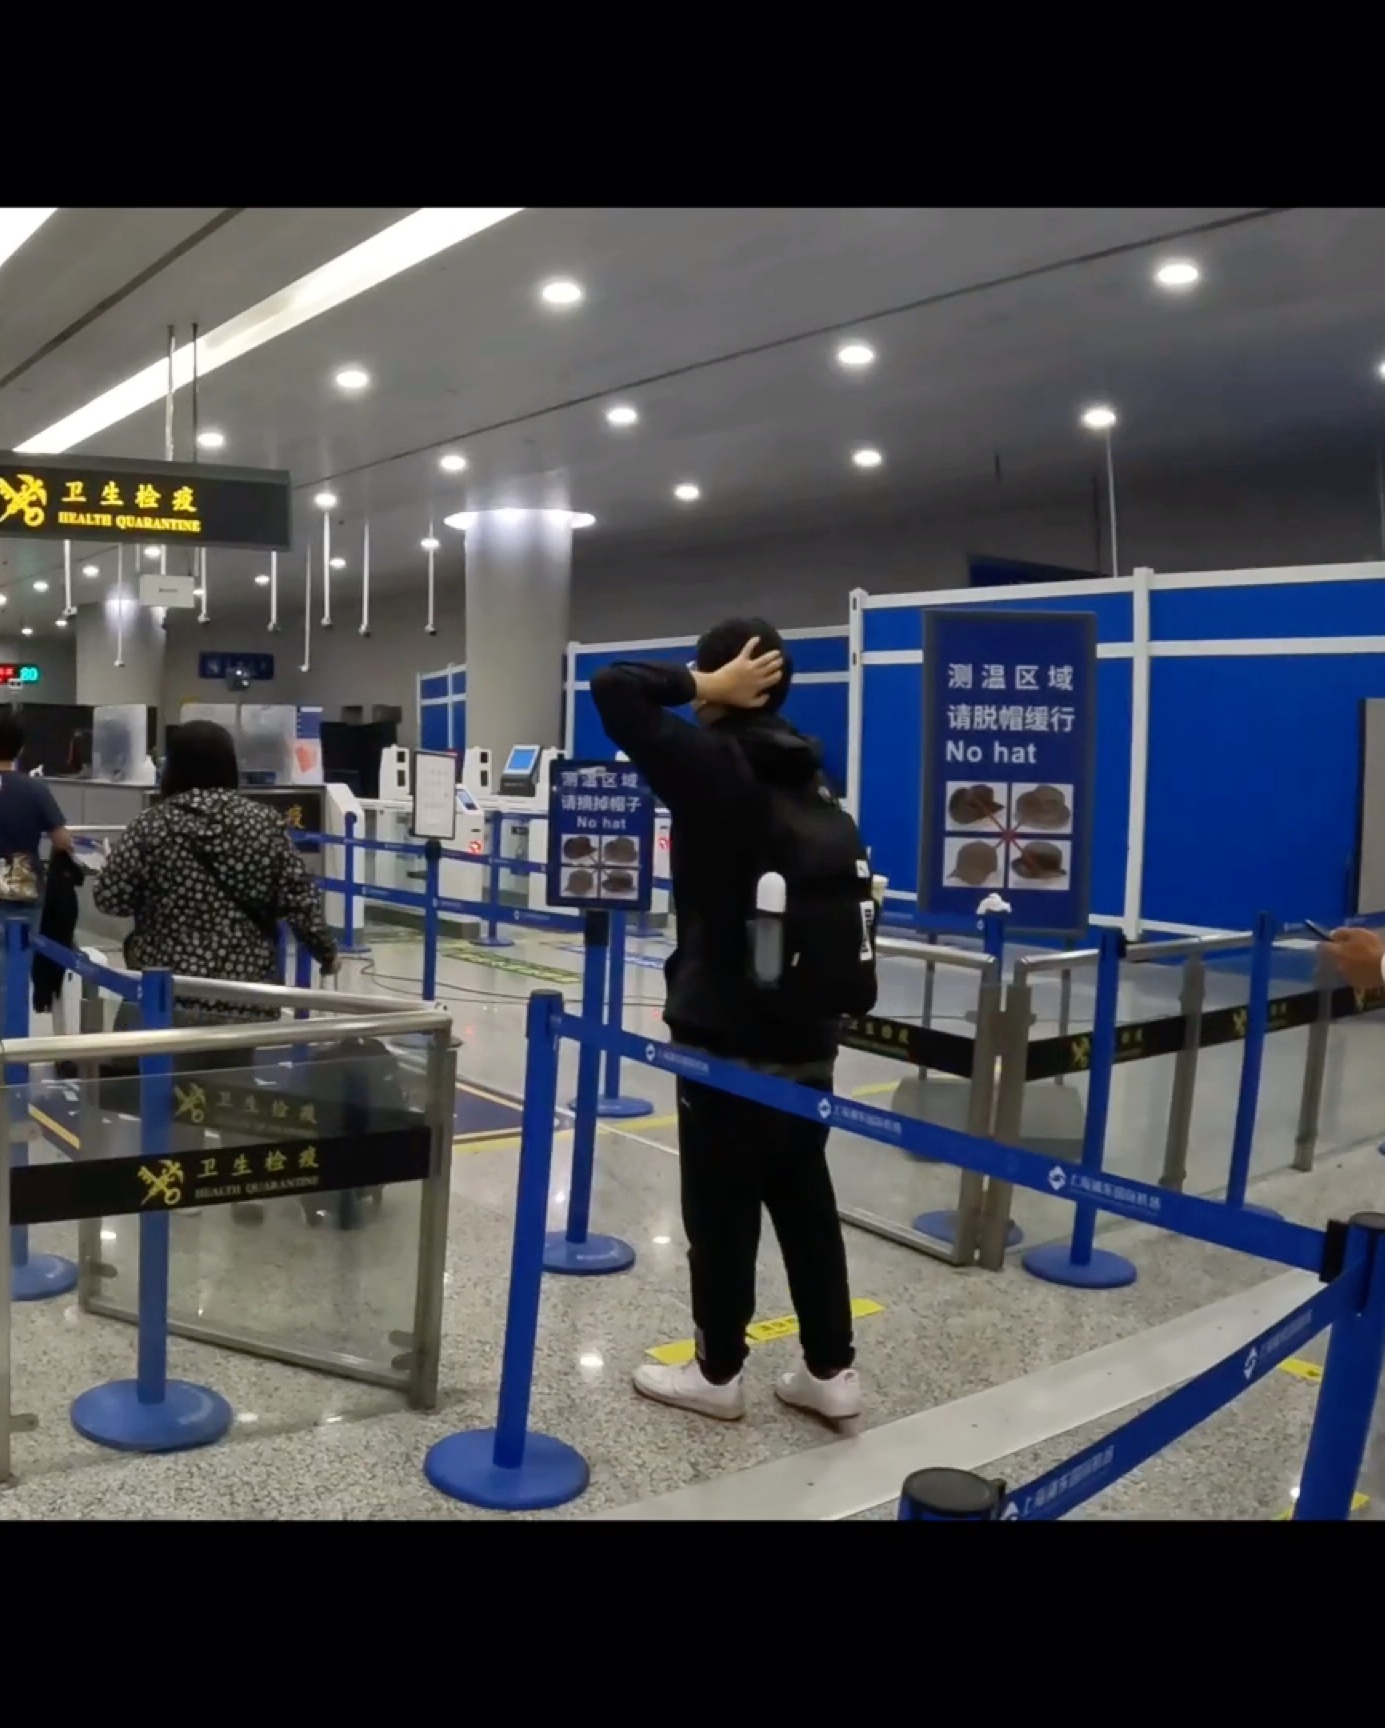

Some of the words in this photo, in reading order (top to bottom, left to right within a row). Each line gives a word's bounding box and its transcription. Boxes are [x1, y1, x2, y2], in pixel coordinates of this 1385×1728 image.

[61, 480, 197, 513] 卫生检疫
[58, 511, 112, 527] HEALTH
[115, 514, 202, 533] QUARANTINE
[20, 667, 39, 681] 80
[947, 663, 1074, 692] 测温区域
[947, 704, 1075, 733] 请脱帽缓行
[946, 741, 982, 763] No
[994, 741, 1036, 764] hat
[577, 816, 597, 829] No
[602, 816, 626, 830] hat
[197, 1145, 319, 1179] 卫生检疫
[194, 1184, 241, 1200] HEALTH
[245, 1174, 320, 1194] QUARANTINE
